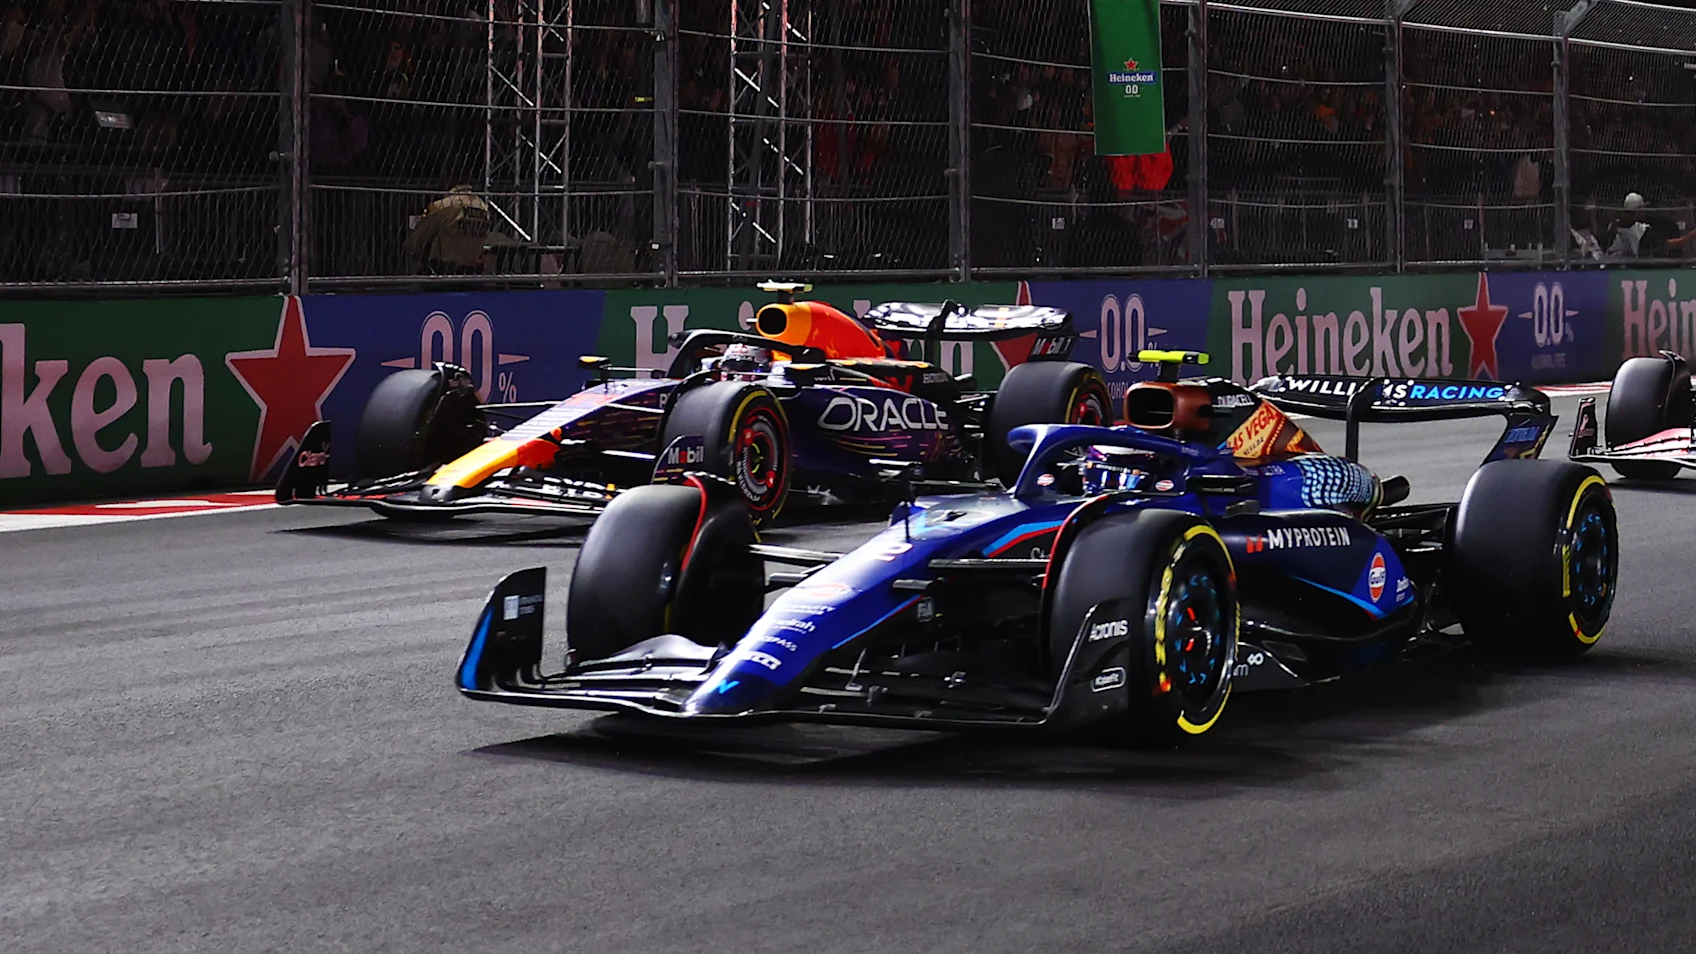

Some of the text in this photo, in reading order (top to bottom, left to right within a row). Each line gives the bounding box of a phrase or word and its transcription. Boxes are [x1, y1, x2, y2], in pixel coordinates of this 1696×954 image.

[1108, 72, 1155, 83] Heineken
[1228, 287, 1453, 387] Heineken
[1288, 378, 1504, 400] WILLIS RACING
[817, 397, 950, 432] ORACLE
[667, 446, 704, 465] Mobil
[1266, 527, 1351, 550] MYPROTEIN
